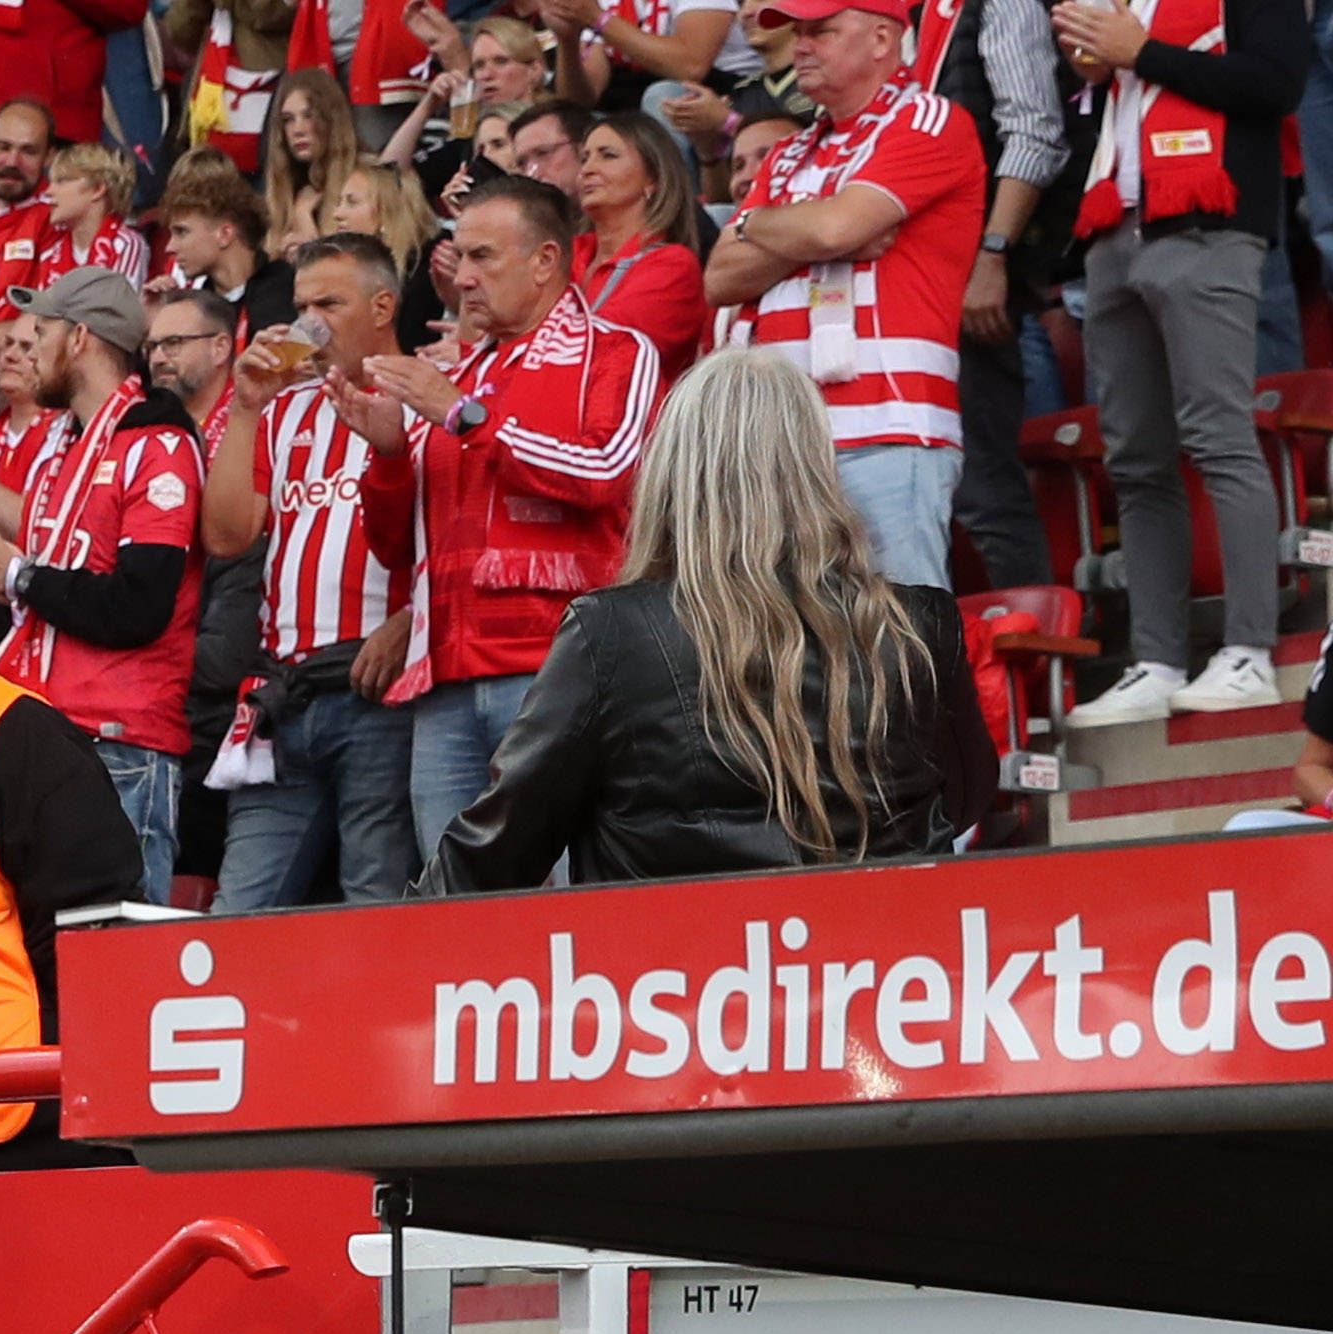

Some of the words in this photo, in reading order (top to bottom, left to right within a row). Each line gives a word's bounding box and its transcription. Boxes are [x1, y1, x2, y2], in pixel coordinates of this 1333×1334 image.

[279, 468, 363, 514] wefo
[432, 889, 1333, 1086] mbsdirekt.de
[684, 1285, 721, 1314] HT
[728, 1284, 759, 1313] 47
